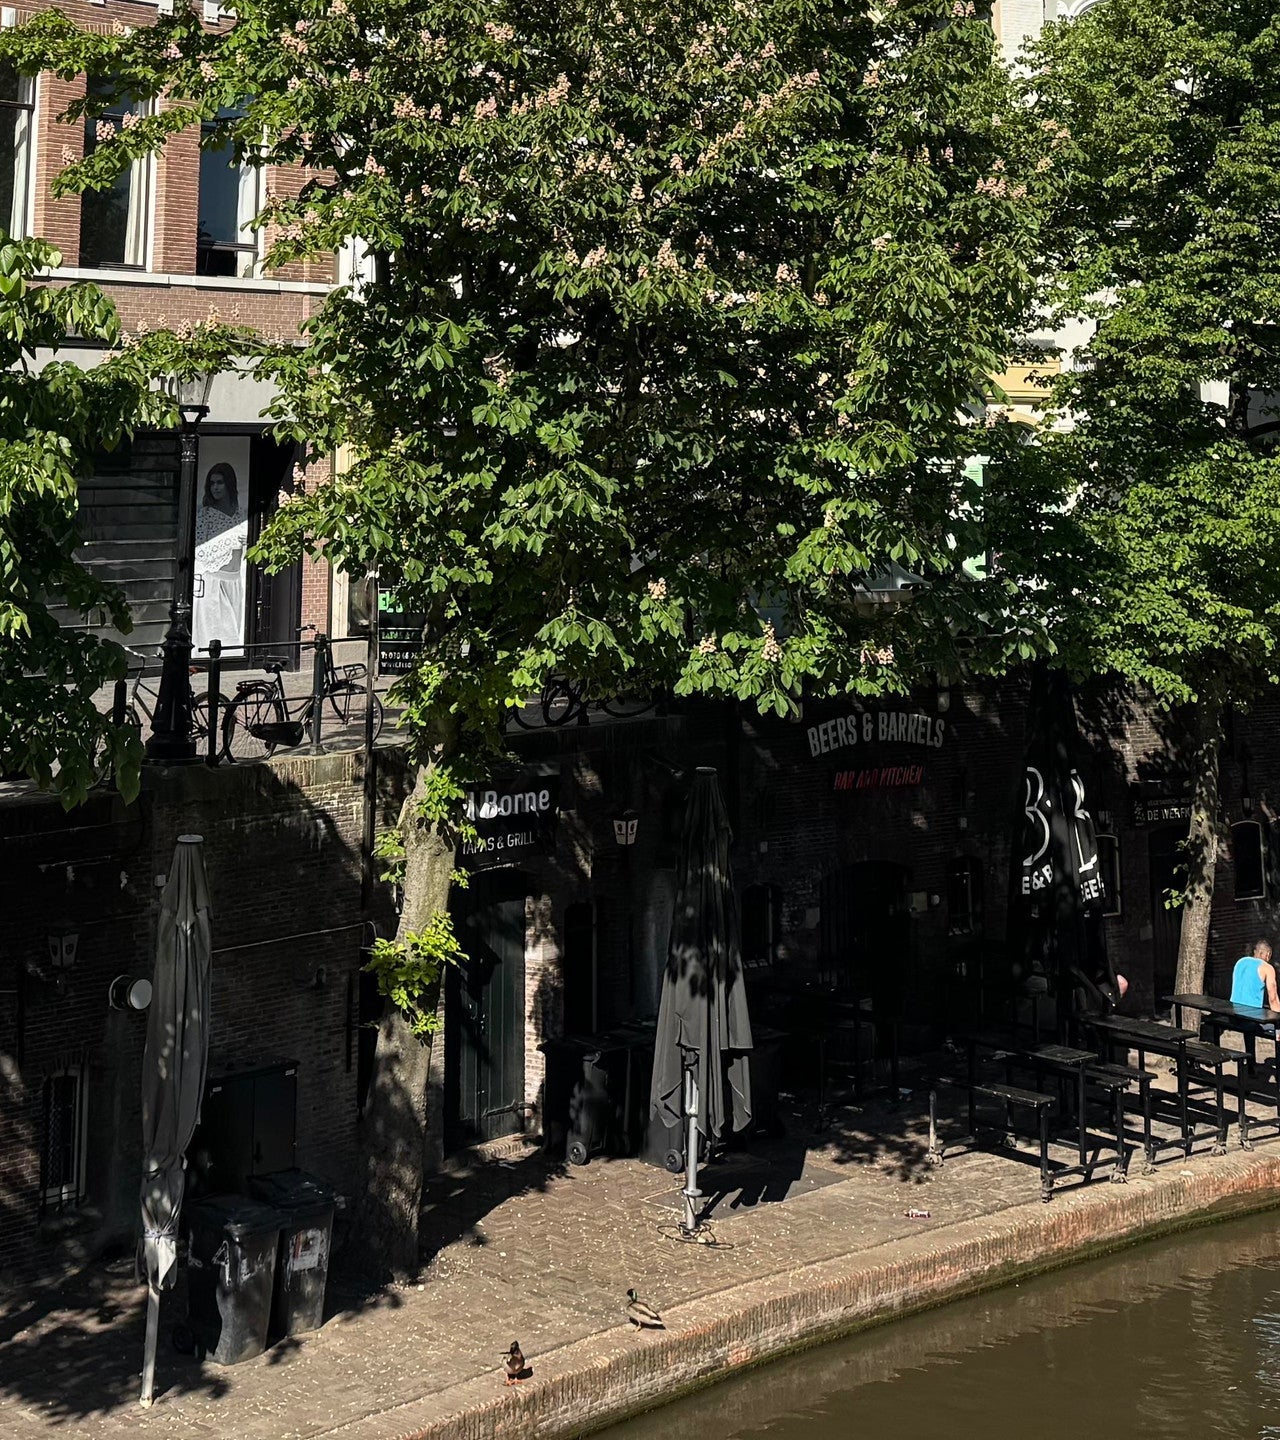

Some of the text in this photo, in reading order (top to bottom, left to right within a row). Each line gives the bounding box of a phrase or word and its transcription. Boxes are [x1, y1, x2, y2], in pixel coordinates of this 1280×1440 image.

[806, 711, 945, 758] BEERS & BARRELS
[879, 764, 924, 787] KITCHEN
[480, 789, 551, 819] Borne
[496, 835, 505, 850] &
[506, 831, 536, 848] GRILL
